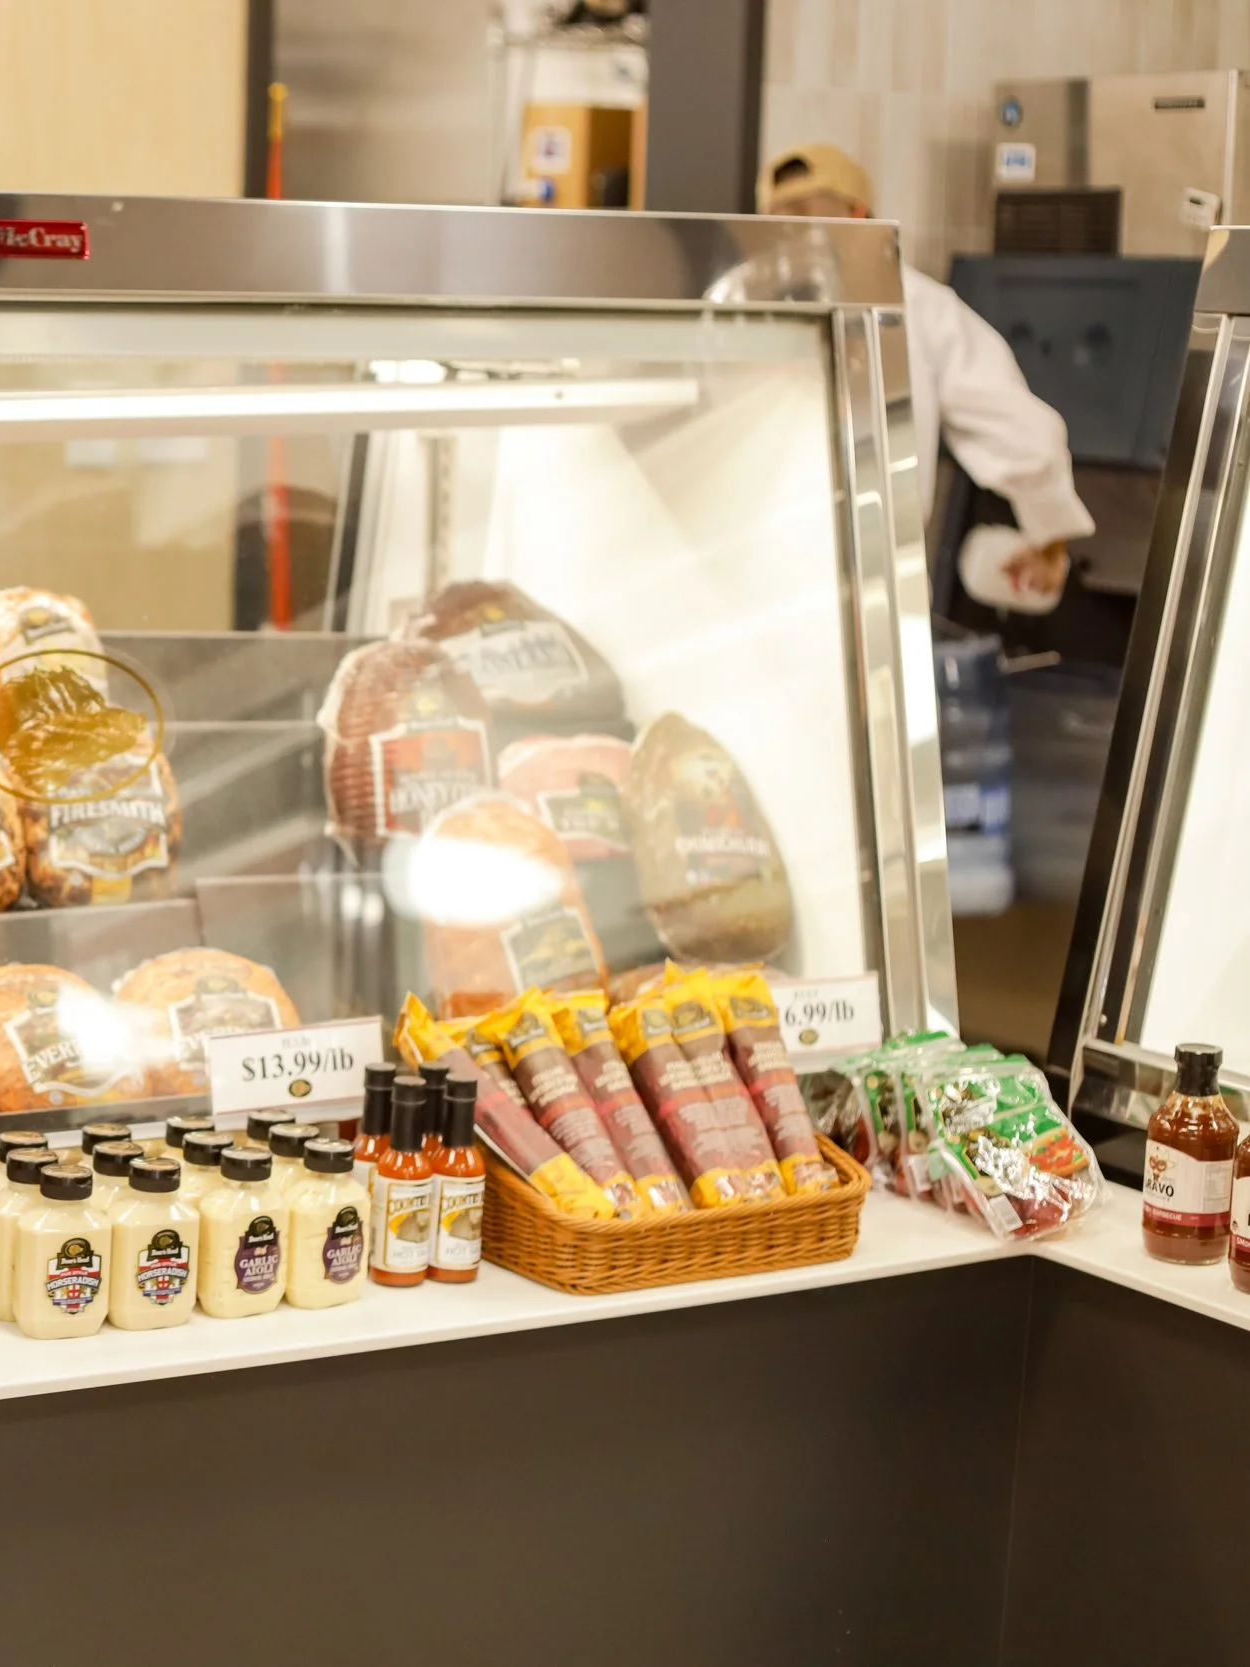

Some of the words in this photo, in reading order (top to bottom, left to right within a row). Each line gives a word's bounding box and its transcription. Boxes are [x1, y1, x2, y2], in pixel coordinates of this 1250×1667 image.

[51, 799, 164, 827] FIRESMITH
[784, 1000, 855, 1027] 6.99/lb
[241, 1049, 354, 1082] $13.99/lb
[1145, 1177, 1175, 1198] RAVO
[326, 1244, 362, 1260] GARLIC
[239, 1254, 279, 1270] GARLIC
[244, 1263, 274, 1277] AIOLI
[137, 1267, 188, 1283] HORSERADISH
[46, 1276, 100, 1292] HORSERADISH
